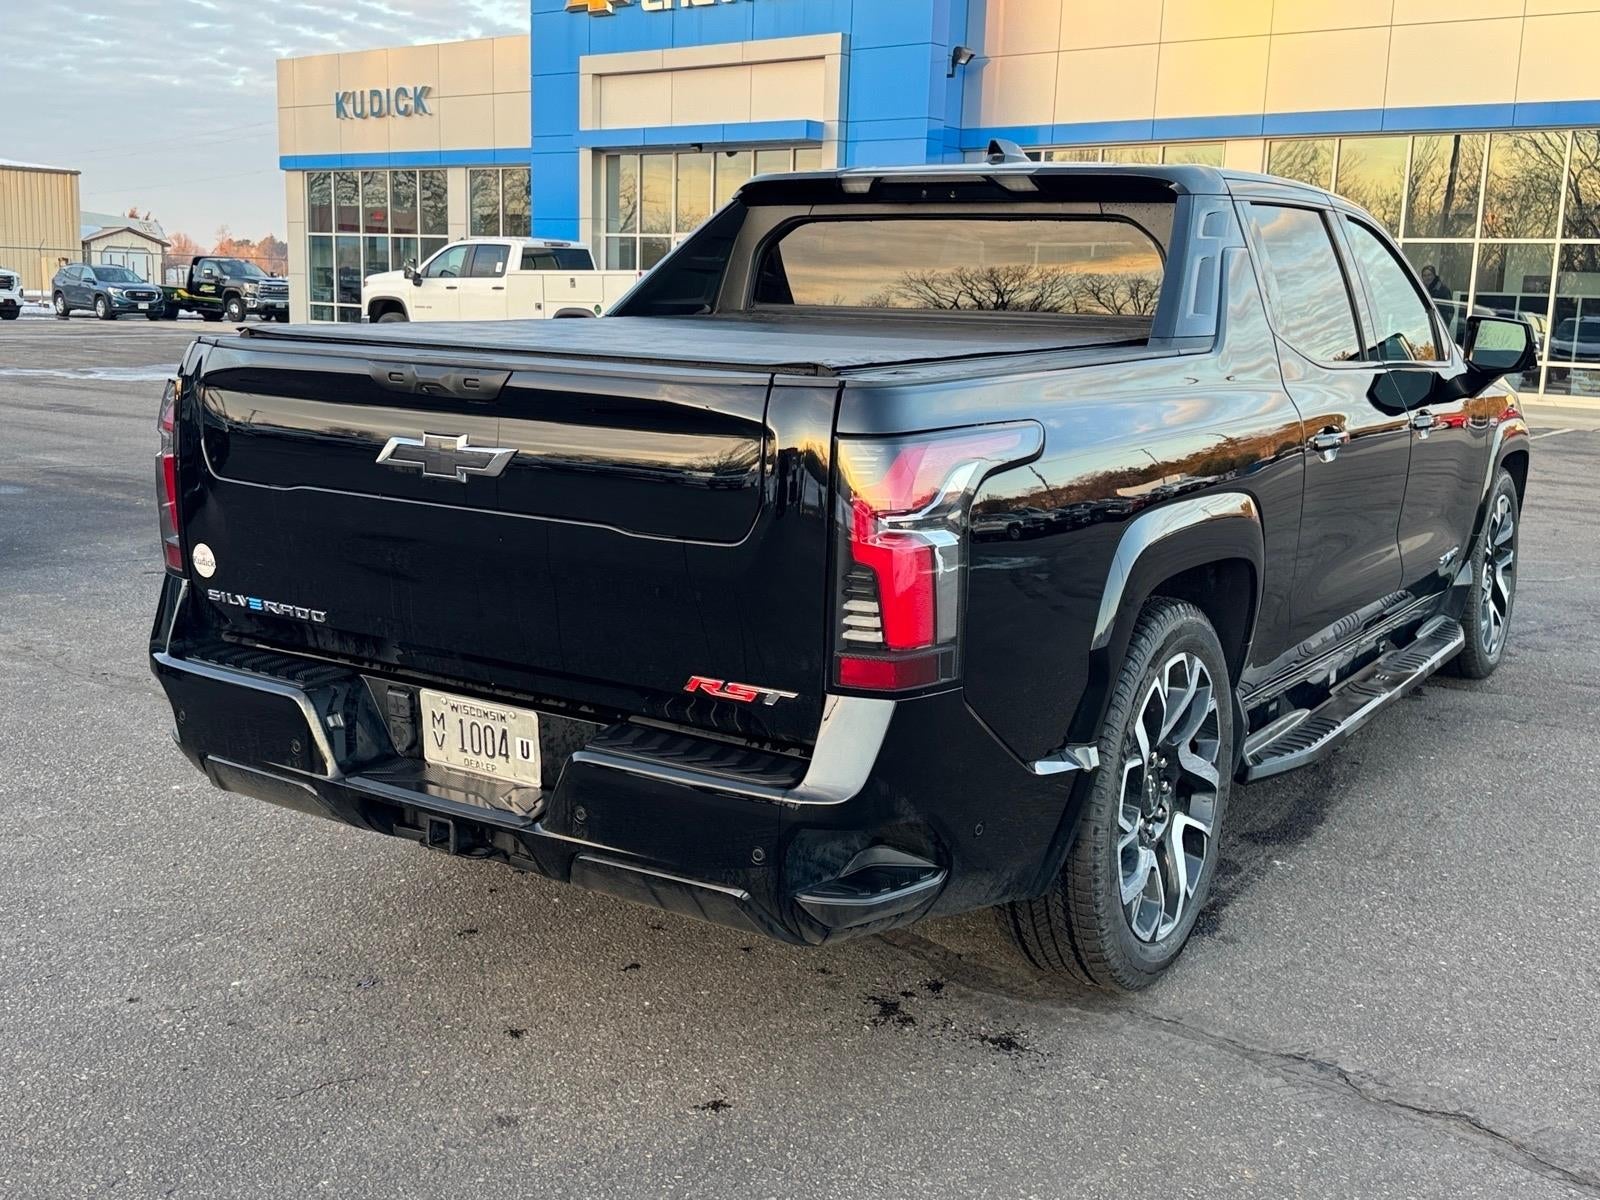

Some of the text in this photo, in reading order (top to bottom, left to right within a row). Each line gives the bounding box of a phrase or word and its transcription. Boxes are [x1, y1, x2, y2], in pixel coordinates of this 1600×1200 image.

[336, 86, 432, 119] KUDICK
[207, 589, 327, 623] SILVERADO
[683, 676, 799, 706] RST
[450, 702, 507, 723] WISCONSIN
[459, 718, 510, 763] 1004
[520, 740, 530, 759] U
[463, 758, 497, 773] DEALER
